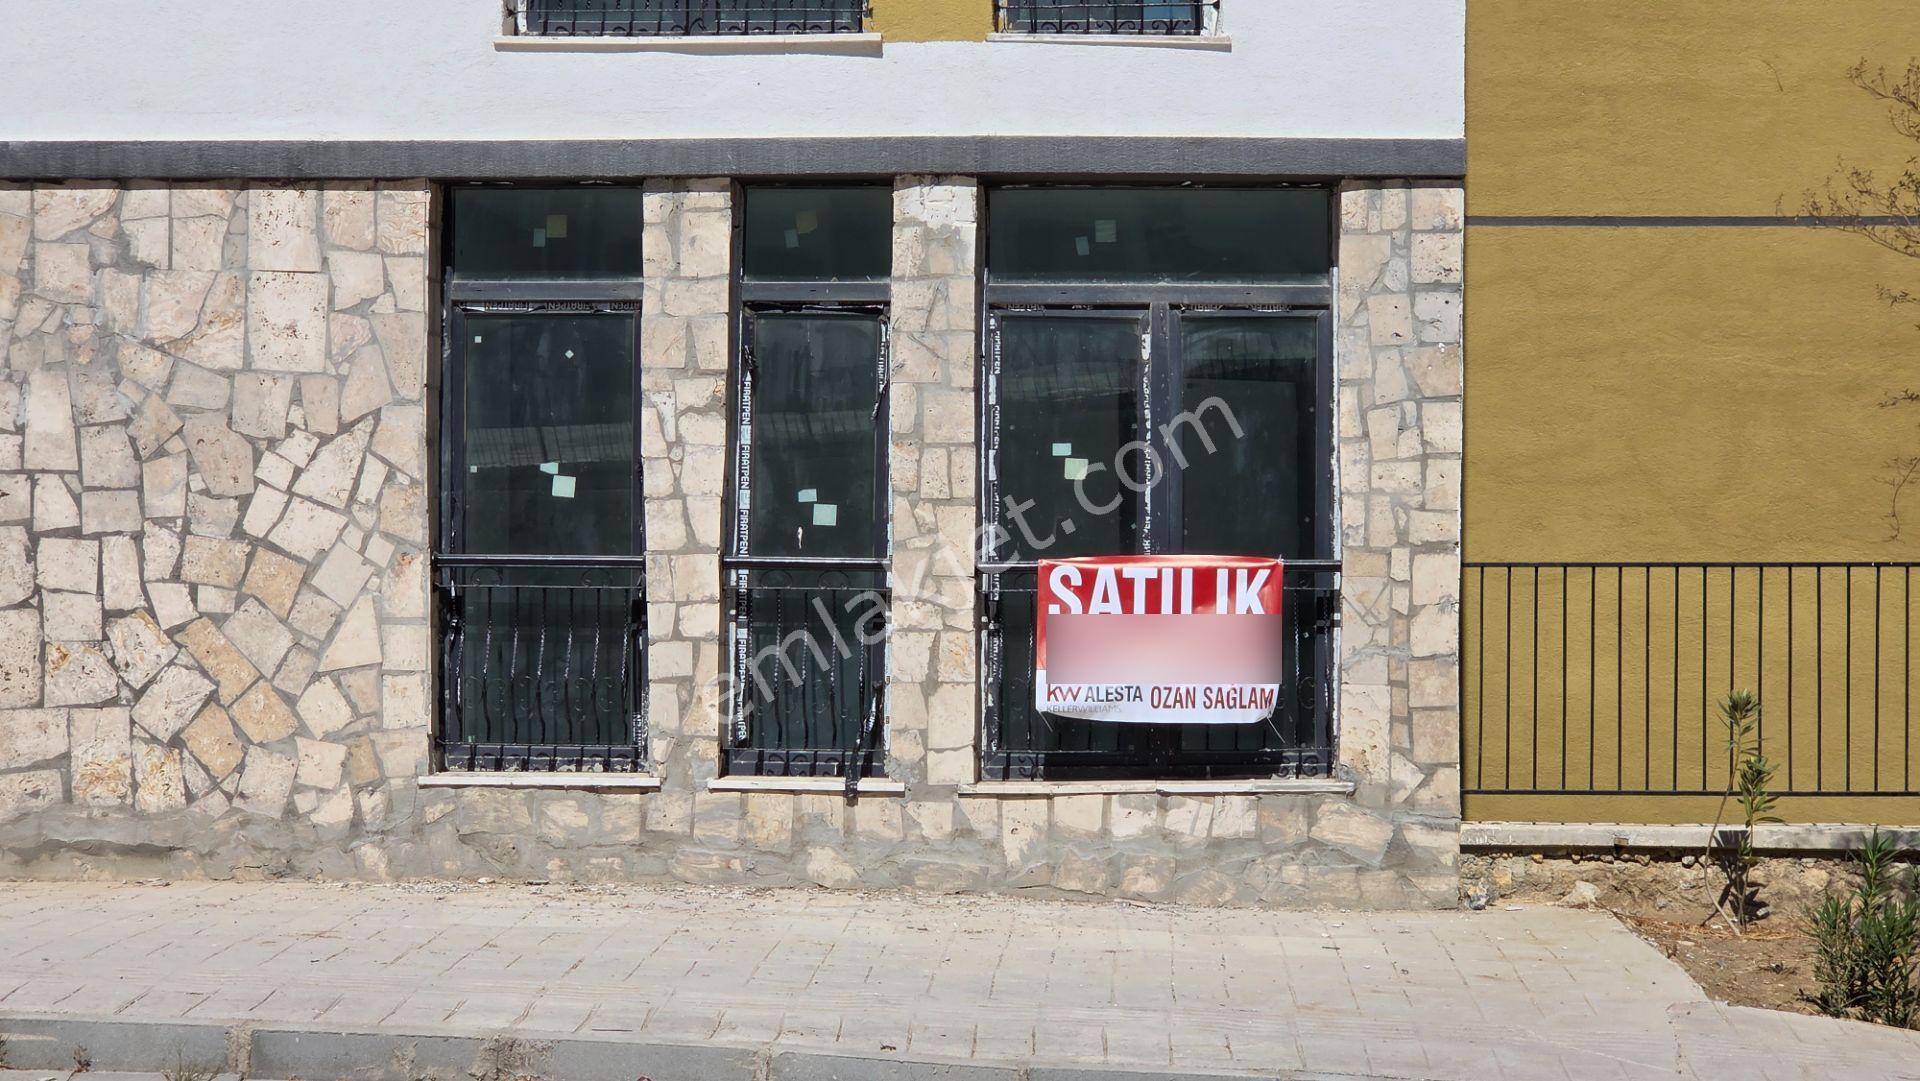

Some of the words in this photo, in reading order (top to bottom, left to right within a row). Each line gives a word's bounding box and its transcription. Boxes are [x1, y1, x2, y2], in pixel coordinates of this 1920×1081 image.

[741, 381, 752, 425] FIRATPEN
[740, 444, 751, 489] FIRATPEN
[739, 509, 750, 554] FIRATPEN
[1084, 686, 1143, 703] ALESTA
[1150, 686, 1197, 710] OZAN
